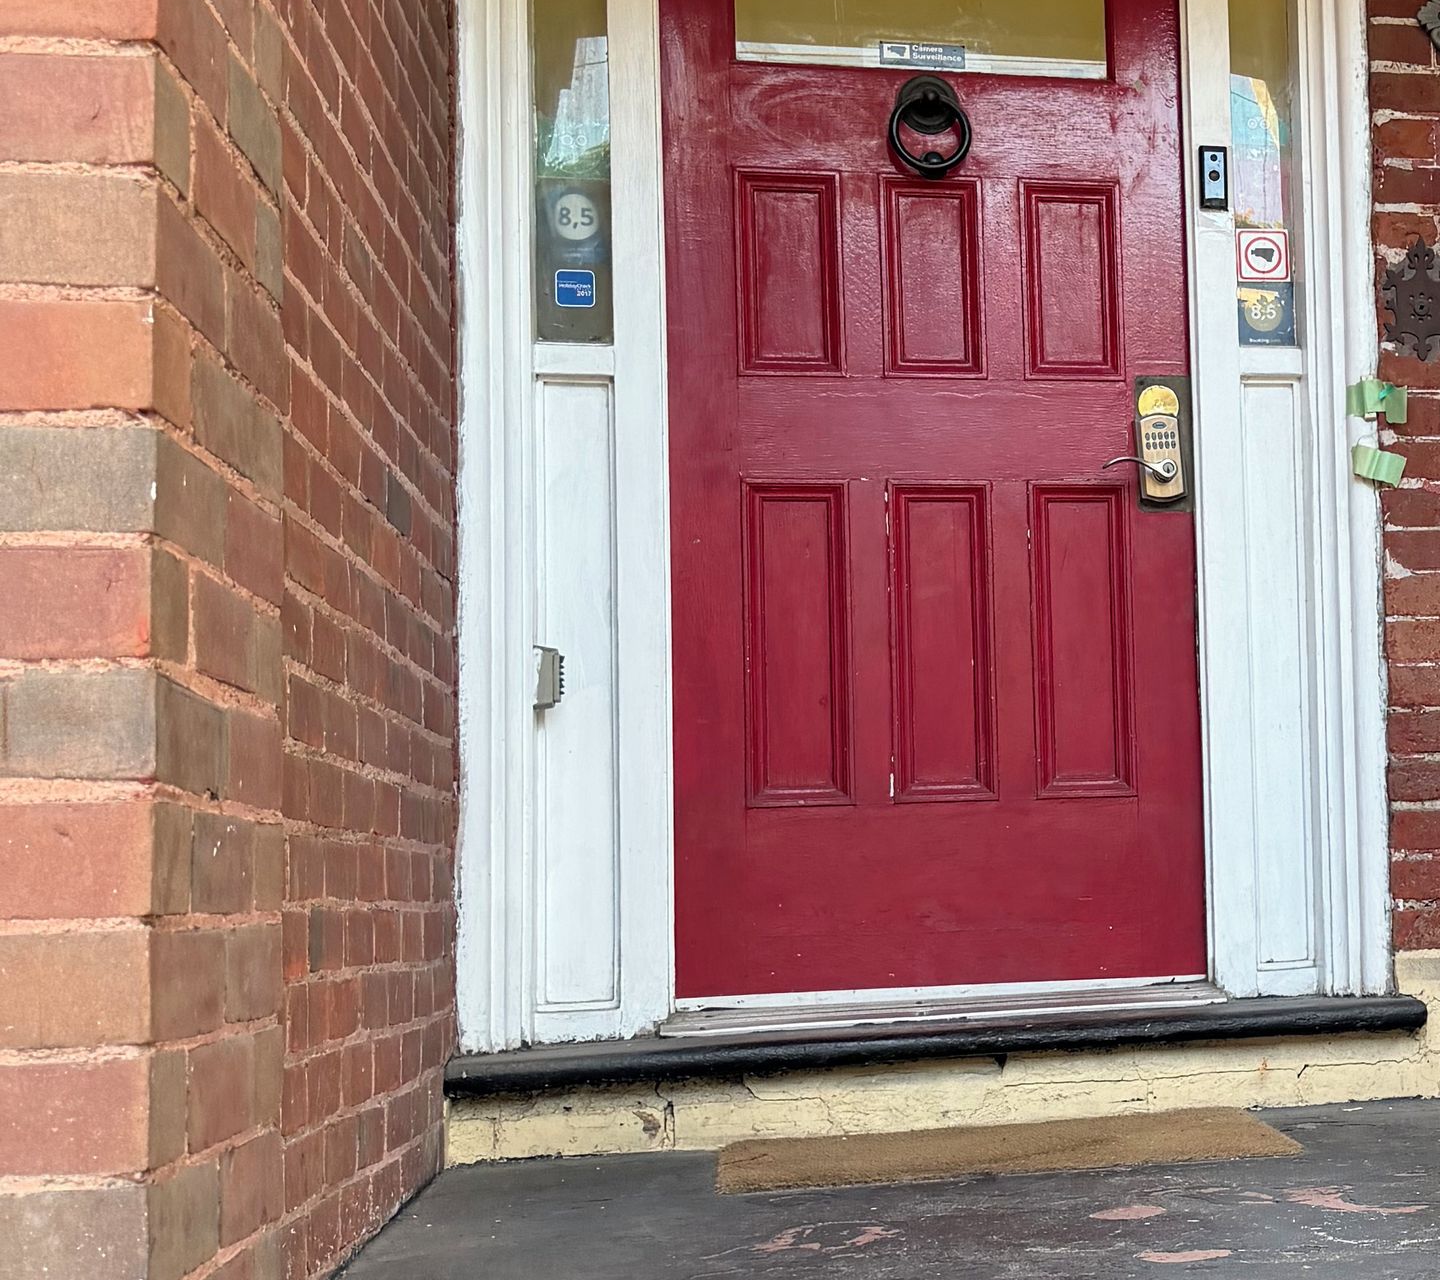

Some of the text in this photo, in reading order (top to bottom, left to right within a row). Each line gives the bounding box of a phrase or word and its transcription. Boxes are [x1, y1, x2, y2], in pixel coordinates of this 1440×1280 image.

[911, 44, 944, 53] Camera
[911, 52, 963, 62] Surveillance
[559, 206, 595, 230] 8,5
[1250, 303, 1277, 321] 8,5
